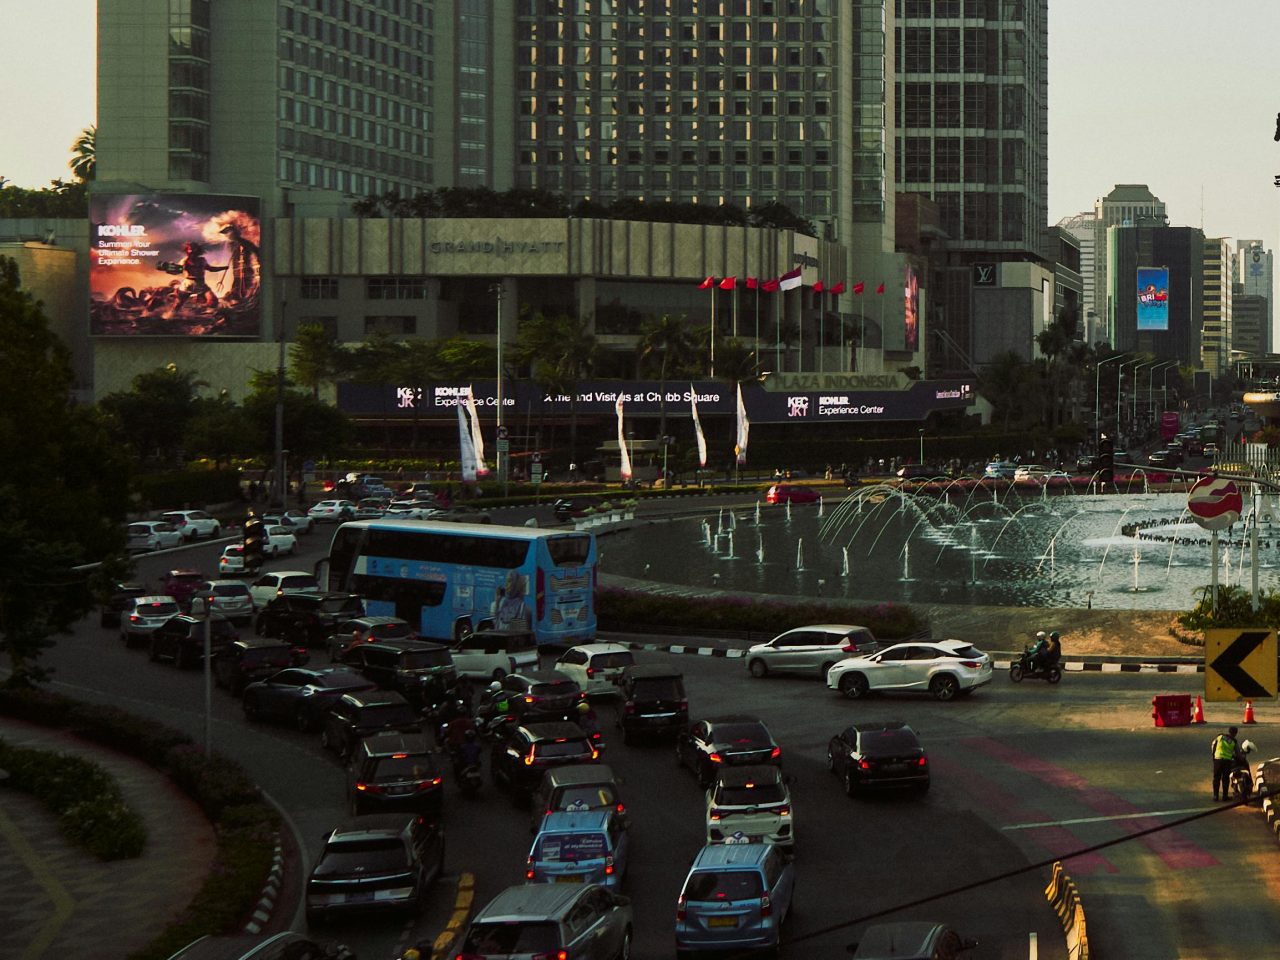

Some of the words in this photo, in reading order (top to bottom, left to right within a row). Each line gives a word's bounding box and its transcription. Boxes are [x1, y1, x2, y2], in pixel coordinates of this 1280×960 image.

[98, 249, 130, 257] Ultimate
[430, 241, 495, 254] GRAND
[503, 241, 564, 254] HYATT
[774, 375, 820, 390] PLAZA
[824, 375, 899, 389] INDONESIA
[485, 396, 515, 406] Ceter
[595, 392, 617, 402] Visit
[634, 393, 644, 402] at
[787, 396, 809, 408] KEC
[787, 406, 808, 417] JKT
[819, 405, 859, 416] Experience
[860, 405, 884, 415] Center
